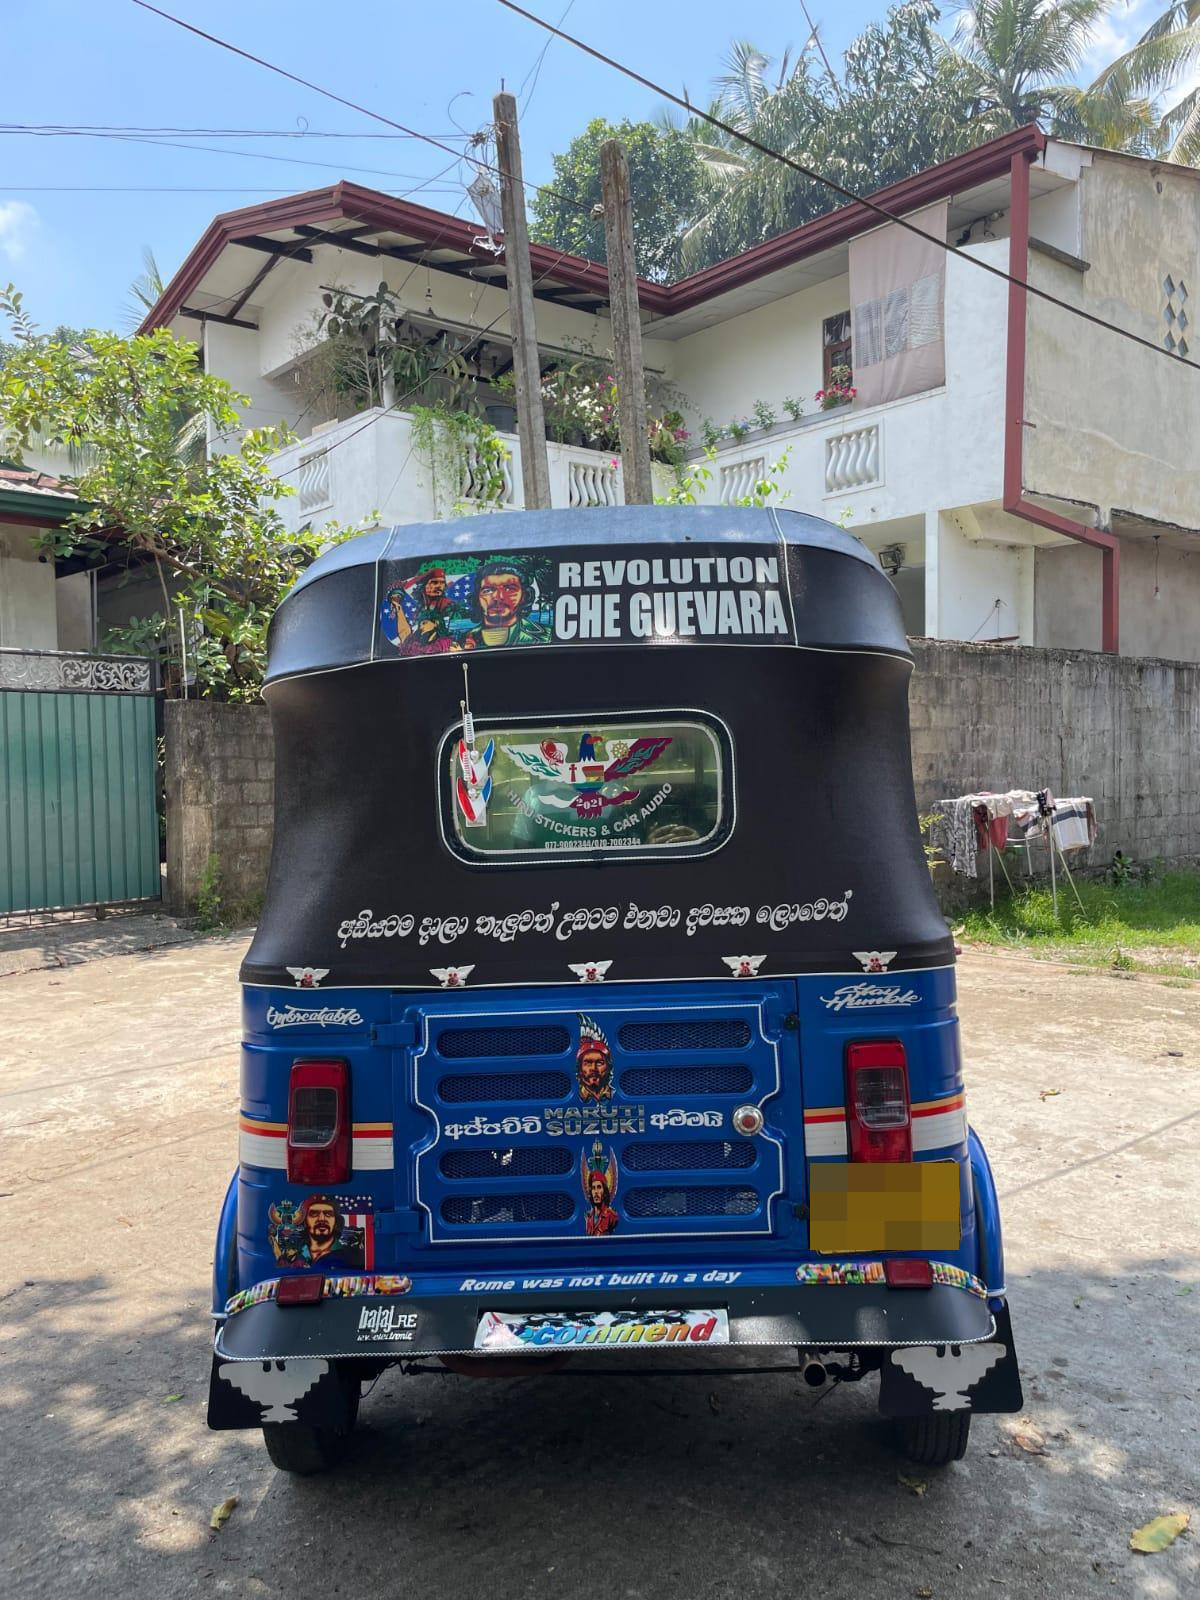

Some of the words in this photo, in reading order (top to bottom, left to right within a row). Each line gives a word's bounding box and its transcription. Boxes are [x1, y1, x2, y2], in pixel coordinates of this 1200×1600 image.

[558, 556, 780, 588] REVOLUTION
[554, 592, 622, 641] CHE
[629, 590, 790, 639] GUEVARA
[506, 789, 534, 818] HIRU
[534, 813, 598, 838] STICKERS
[601, 825, 611, 837] &
[613, 815, 641, 833] CAR
[640, 782, 673, 820] AUDIO
[575, 796, 603, 811] 2021
[418, 916, 469, 946] දාලා
[555, 906, 620, 941] උඩටම
[266, 1004, 364, 1030] Unbreakable
[543, 1104, 645, 1120] MARUTI
[545, 1119, 645, 1136] SUZUKI
[459, 1278, 516, 1291] Rome
[522, 1276, 565, 1289] was
[568, 1274, 605, 1288] not
[607, 1272, 656, 1286] built
[659, 1271, 679, 1284] in
[683, 1273, 698, 1283] a
[702, 1269, 742, 1284] day
[358, 1305, 395, 1333] bajaj
[398, 1313, 418, 1328] RE
